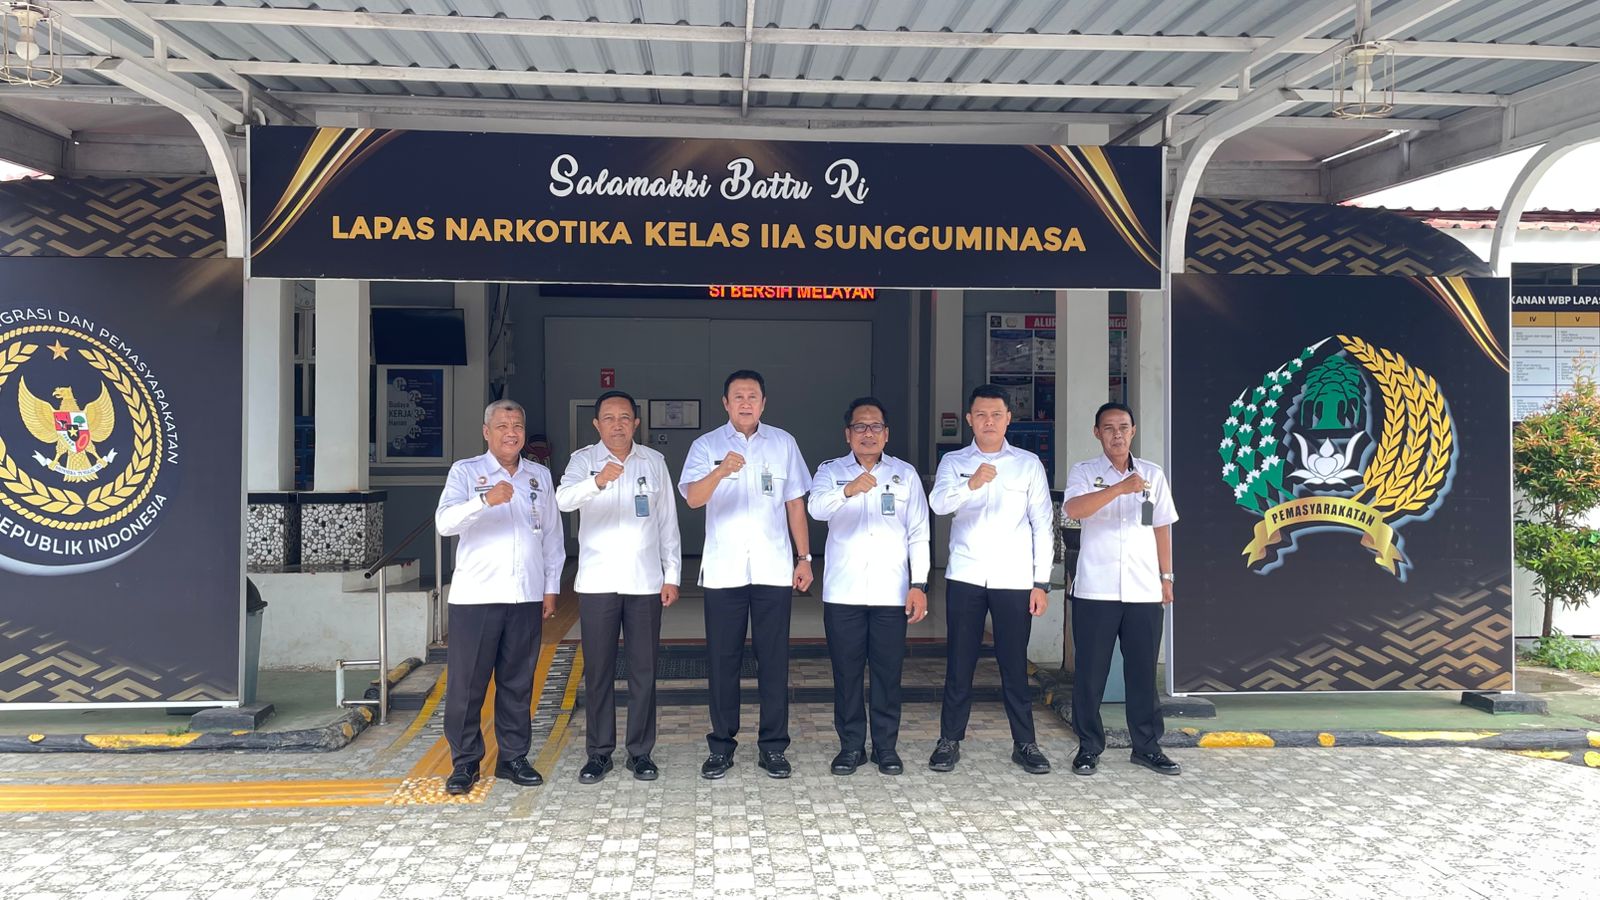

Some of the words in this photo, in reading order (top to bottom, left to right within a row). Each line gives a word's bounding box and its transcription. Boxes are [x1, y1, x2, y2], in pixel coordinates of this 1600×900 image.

[549, 153, 711, 198] Salamakki
[720, 157, 812, 200] Battu
[824, 158, 869, 204] Ri
[332, 215, 435, 240] LAPAS
[446, 217, 632, 245] NARKOTIKA
[645, 221, 750, 248] KELAS
[761, 224, 805, 249] IIA
[814, 224, 1087, 252] SUNGGUMINASA
[730, 285, 792, 299] BERSIH
[797, 286, 875, 300] MELAYAN
[1548, 296, 1571, 305] WBP
[0, 308, 52, 327] GRASI
[58, 311, 95, 332] DAN
[99, 328, 179, 464] PEMASYARAKATAN
[604, 375, 610, 385] 1
[389, 409, 411, 417] KERJA
[0, 514, 83, 555] EPUBLIK
[88, 494, 167, 553] INDONESIA
[1271, 503, 1375, 526] PEMASYARAKATAN
